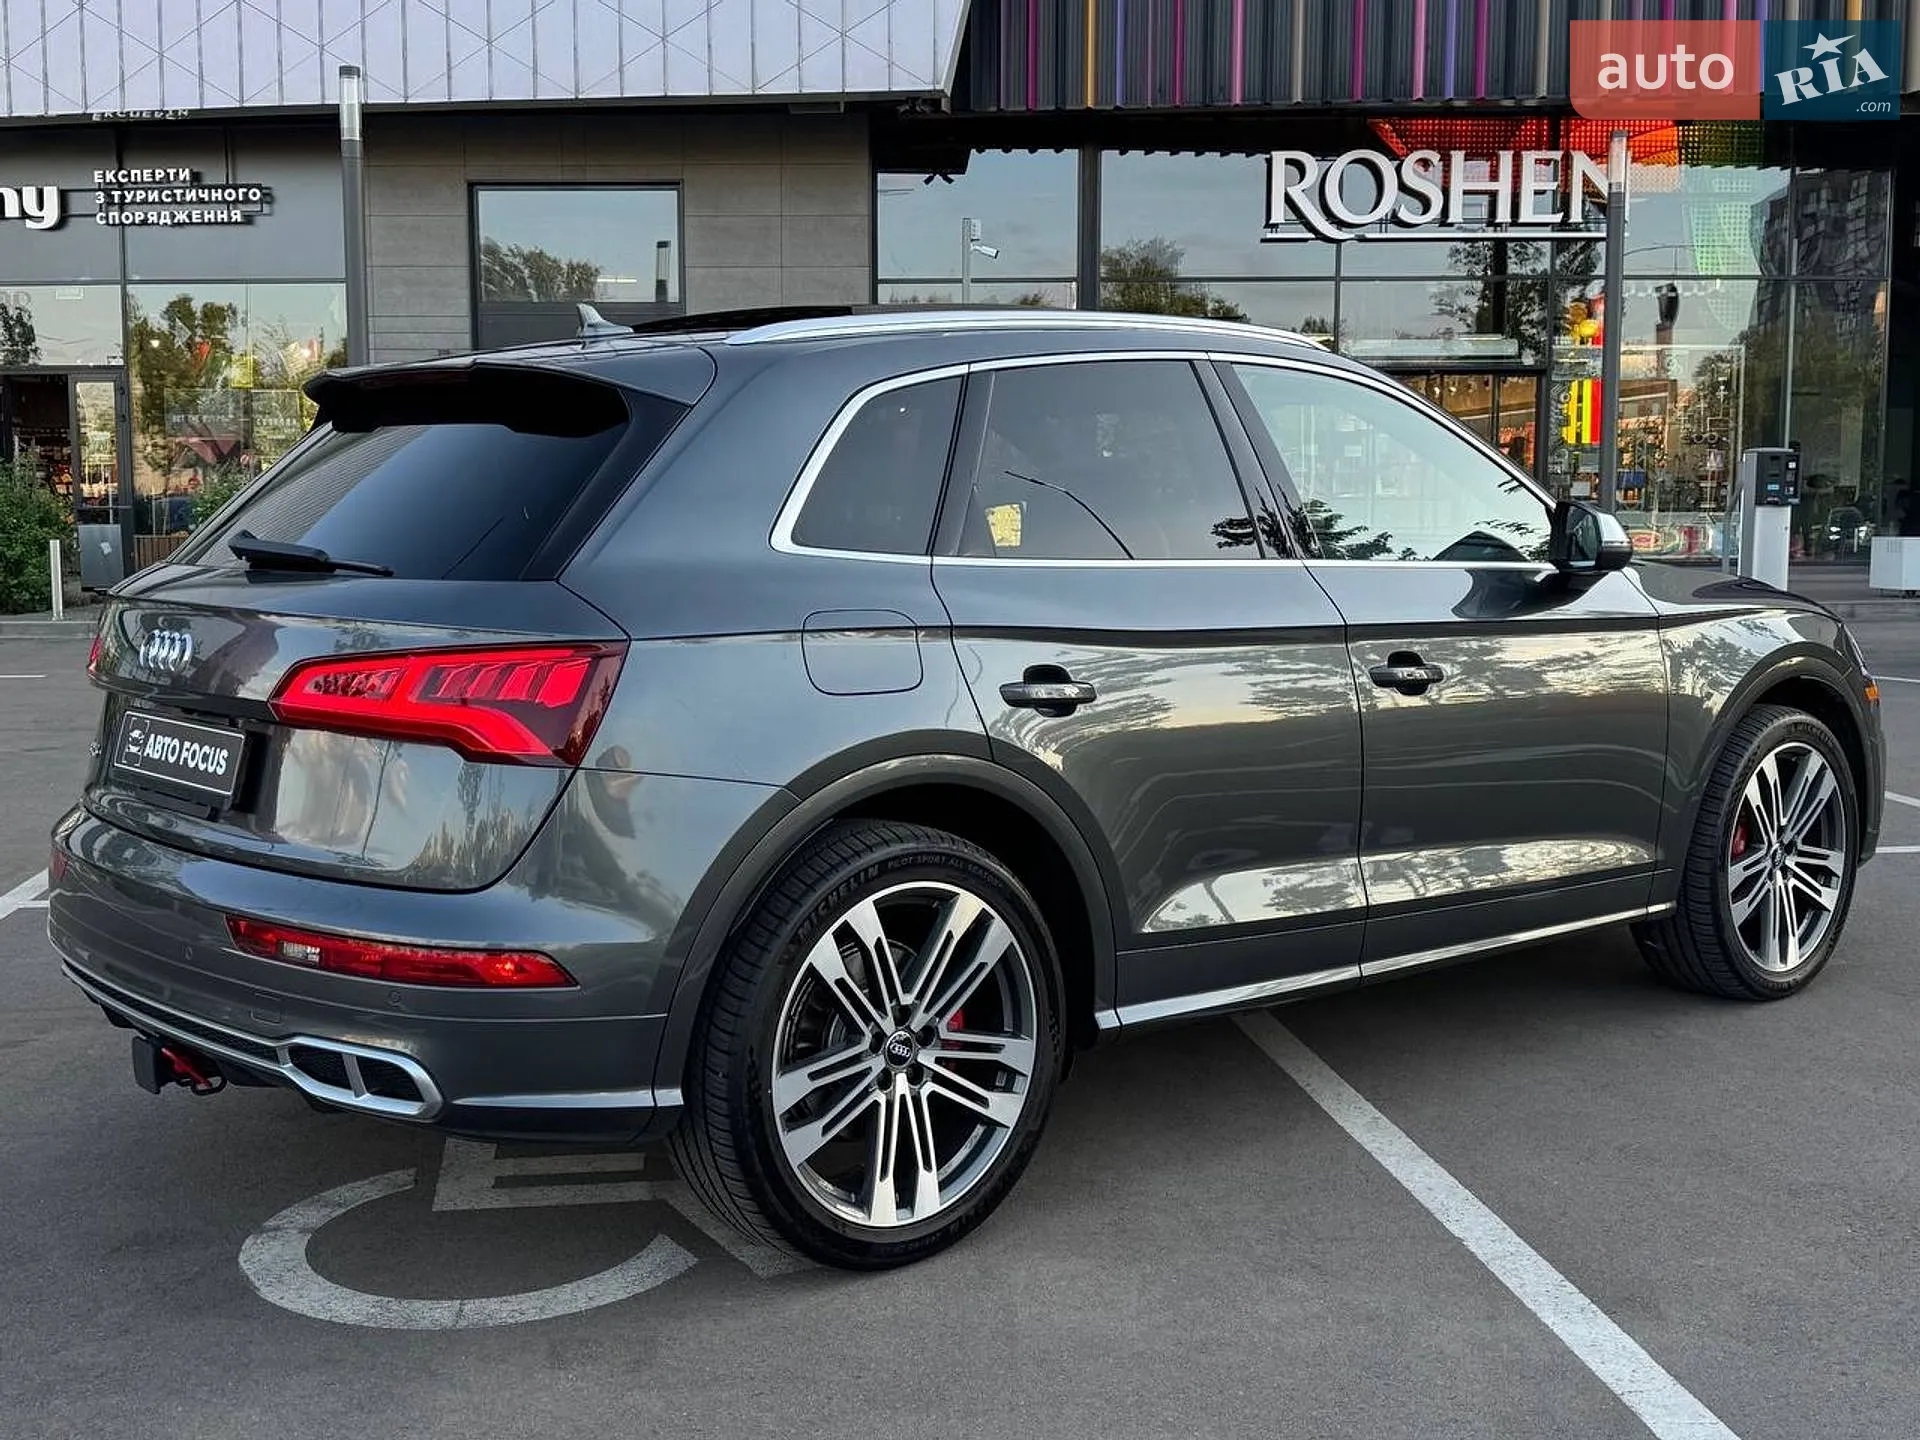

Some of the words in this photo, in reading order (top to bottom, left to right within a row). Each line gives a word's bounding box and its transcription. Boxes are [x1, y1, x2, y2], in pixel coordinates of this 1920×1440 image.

[94, 168, 190, 183] ЕКСПЕРТИ
[111, 188, 261, 203] ТУРИСТИЧНОГО
[1268, 149, 1630, 240] ROSHEN
[96, 209, 242, 225] СПОРЯДЖЕННЯ
[179, 740, 229, 775] FOCUS
